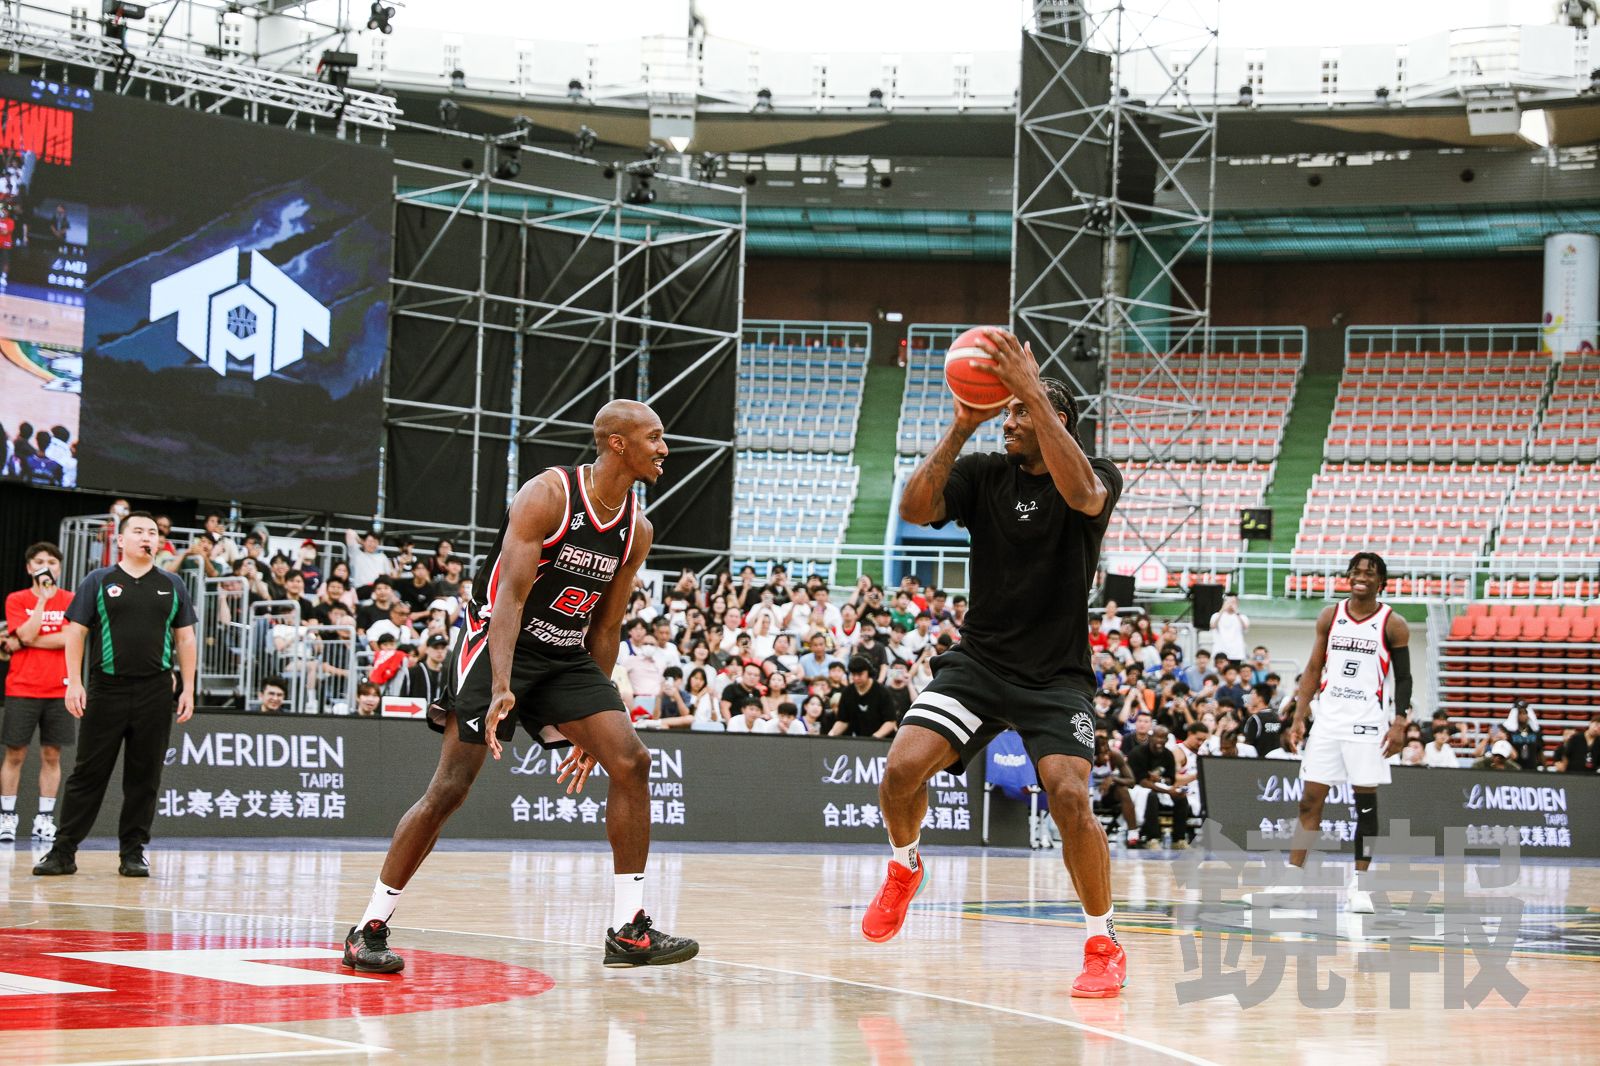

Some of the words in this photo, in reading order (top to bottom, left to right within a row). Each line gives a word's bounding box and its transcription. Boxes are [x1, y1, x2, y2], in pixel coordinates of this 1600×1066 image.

[1342, 660, 1361, 678] 5
[181, 732, 344, 768] MERIDIEN
[299, 773, 344, 789] TAIPEI
[821, 754, 853, 784] Le
[157, 788, 346, 819] 北寒舍艾美酒店
[510, 794, 686, 825] 台北寒舍酒店
[936, 791, 968, 805] TAIPEI
[1485, 785, 1568, 812] MERIDIEN
[822, 802, 971, 830] 台北寒美酒店
